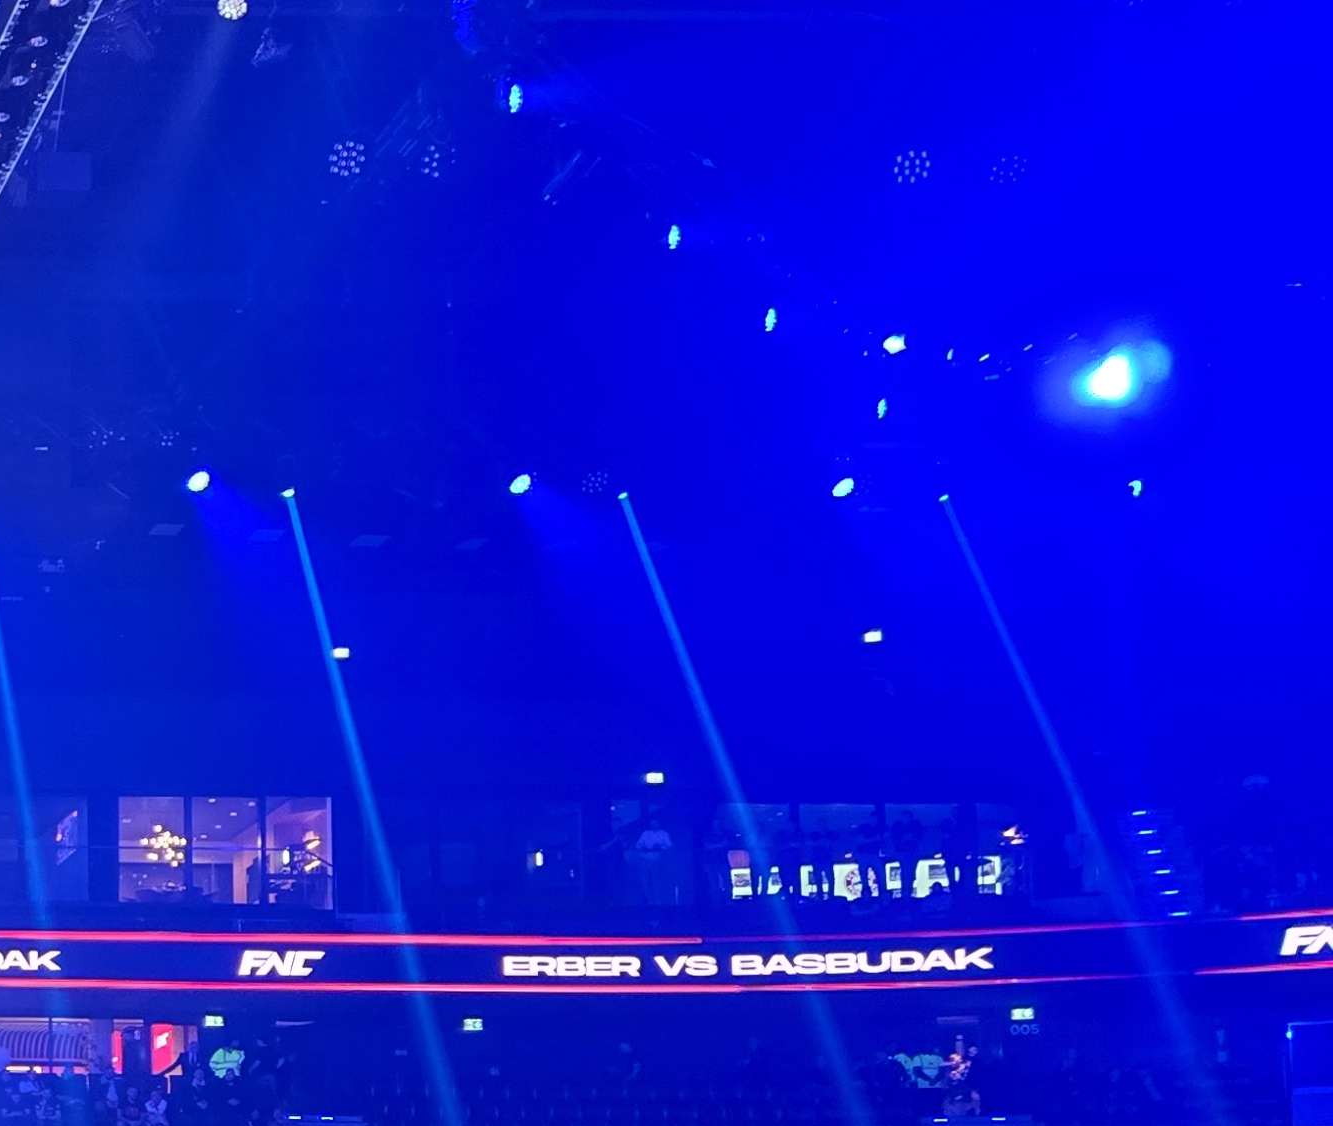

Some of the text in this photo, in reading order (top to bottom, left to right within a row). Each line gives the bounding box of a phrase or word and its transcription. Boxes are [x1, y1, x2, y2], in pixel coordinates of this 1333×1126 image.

[237, 949, 326, 977] FNC
[502, 947, 994, 977] ERBER VS BASBUDAK
[1010, 1024, 1040, 1035] 005
